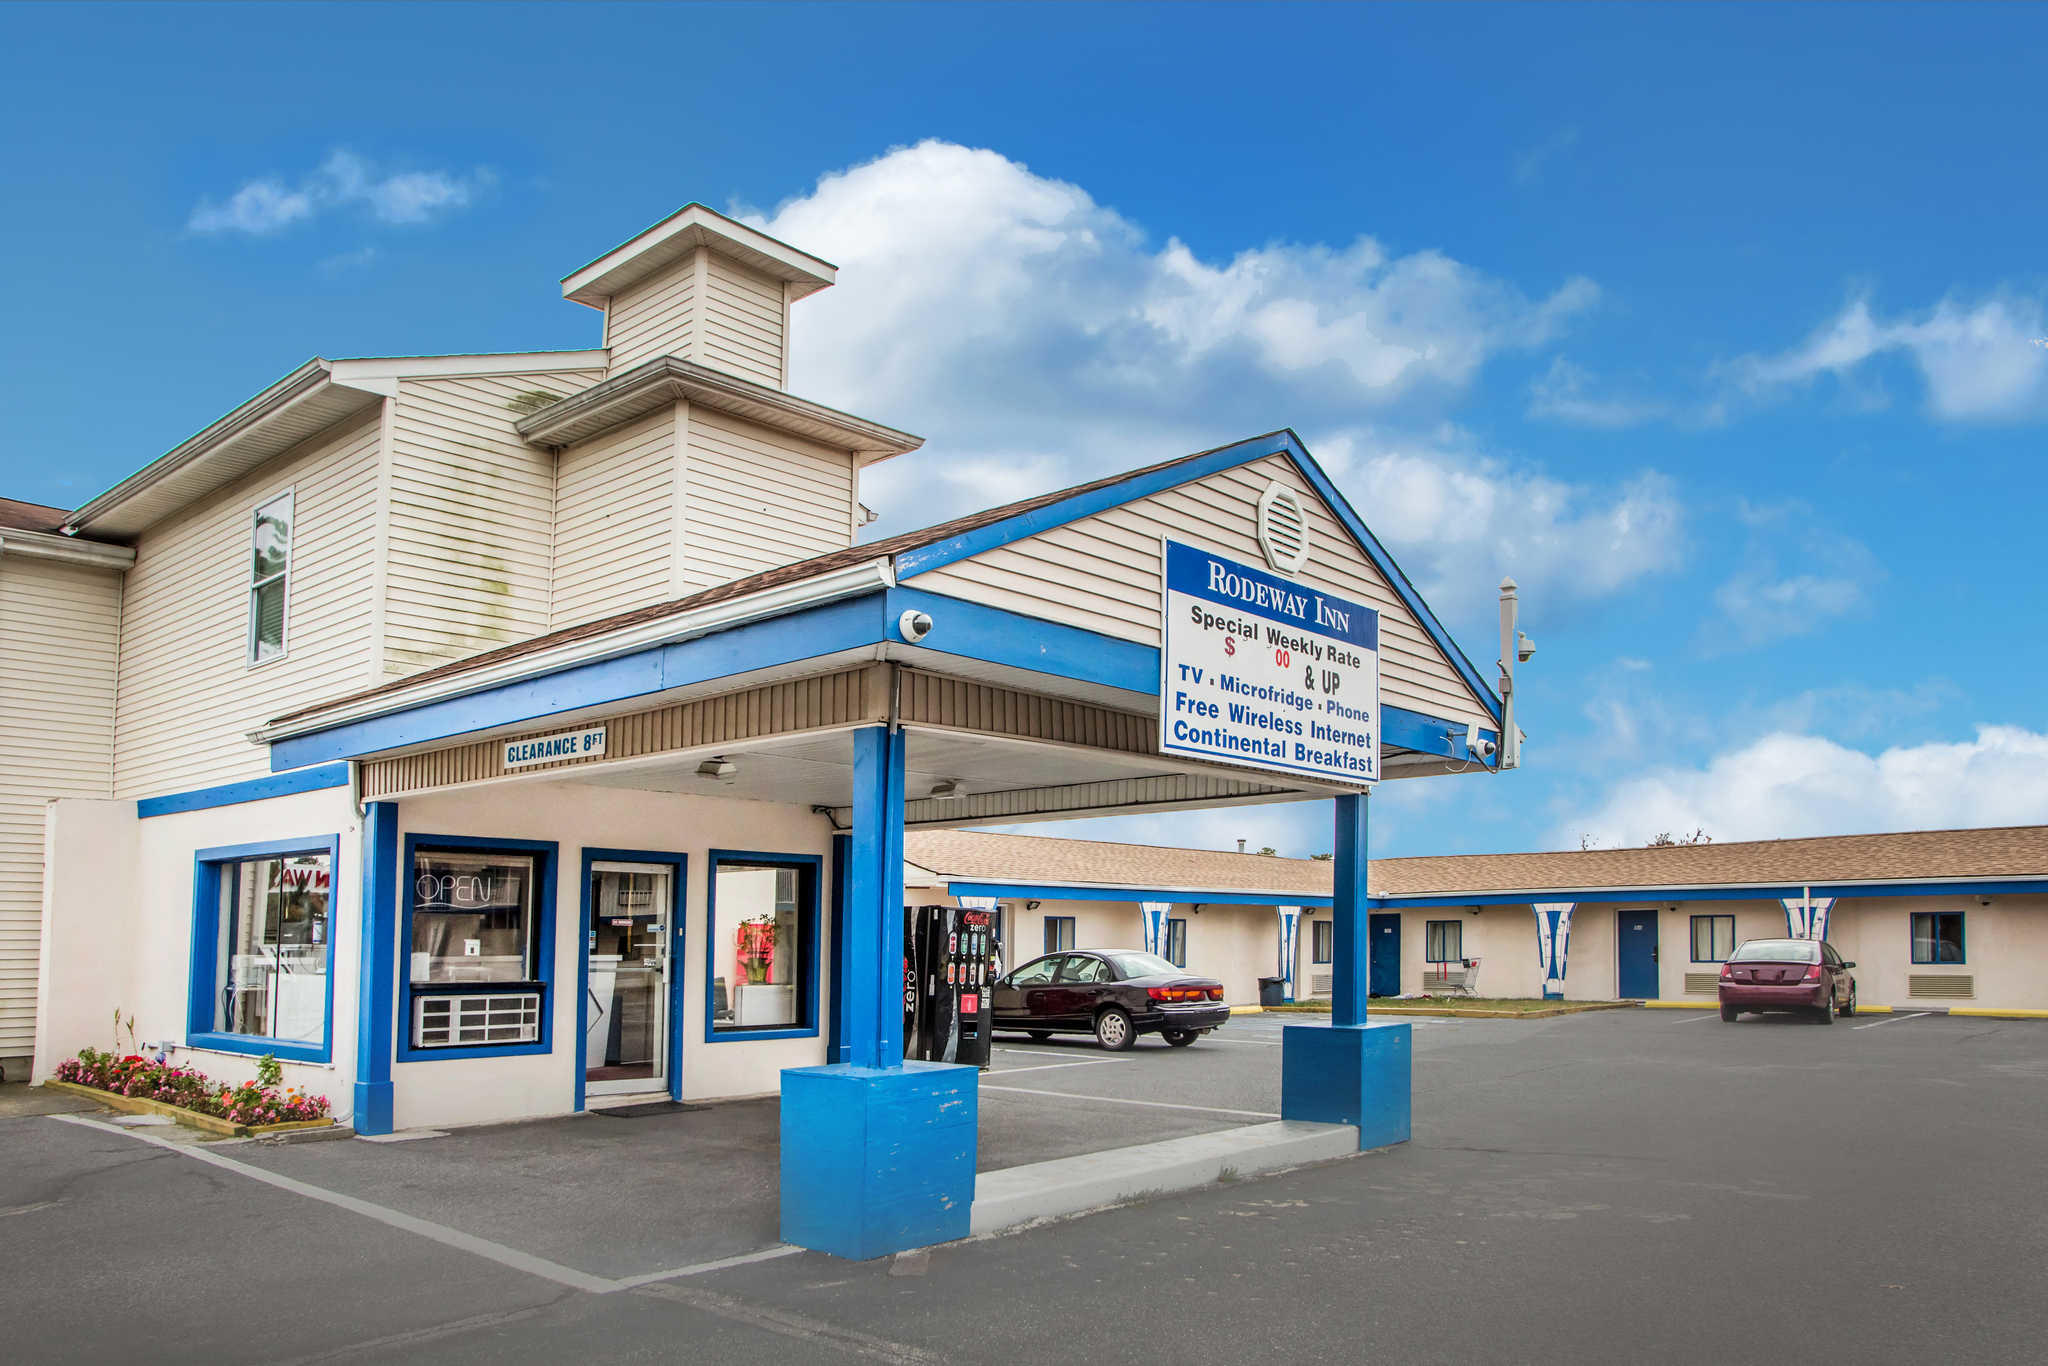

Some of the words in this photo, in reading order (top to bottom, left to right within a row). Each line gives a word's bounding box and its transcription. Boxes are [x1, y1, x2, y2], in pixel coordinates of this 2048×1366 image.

[1207, 560, 1308, 619] RODEWAY
[1315, 596, 1350, 633] INN
[1191, 605, 1258, 640] Special
[1266, 626, 1322, 661] Weekly
[1327, 645, 1361, 669] Rate
[1178, 663, 1204, 685] TV
[1220, 674, 1314, 712] Microfridge
[1326, 699, 1370, 723] Phone
[1224, 635, 1236, 657] $
[1275, 648, 1290, 669] 00
[1304, 664, 1315, 691] &
[1322, 669, 1341, 696] UP
[1173, 719, 1287, 759] Continental
[1294, 742, 1373, 774] Breakfast
[1175, 691, 1220, 719] Free
[1228, 702, 1303, 737] Wireless
[1311, 720, 1372, 749] Internet
[507, 736, 577, 763] CLEARANCE
[416, 874, 491, 902] OPEN
[970, 924, 986, 932] zero
[905, 970, 916, 1013] zero
